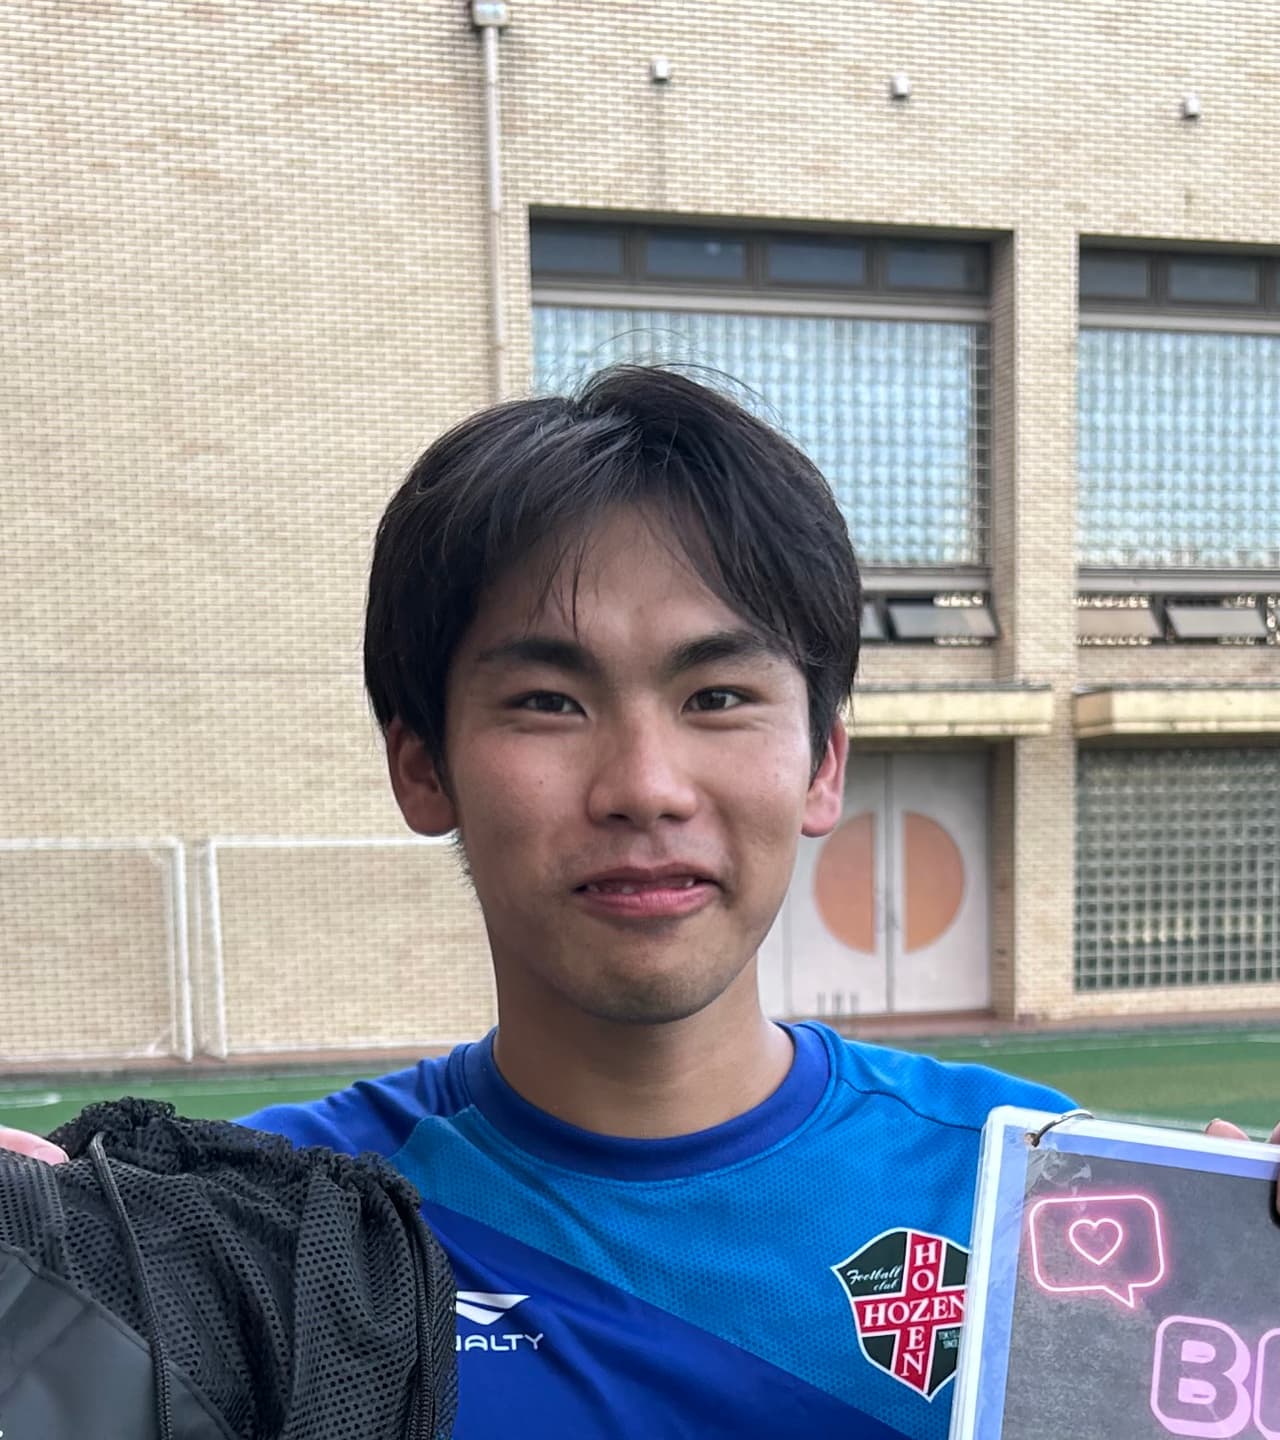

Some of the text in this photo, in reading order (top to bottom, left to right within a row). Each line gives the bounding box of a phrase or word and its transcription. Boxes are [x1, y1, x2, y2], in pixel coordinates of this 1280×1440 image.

[847, 1265, 902, 1285] Football
[863, 1294, 965, 1327] HOZEN
[456, 1333, 544, 1351] ALTY
